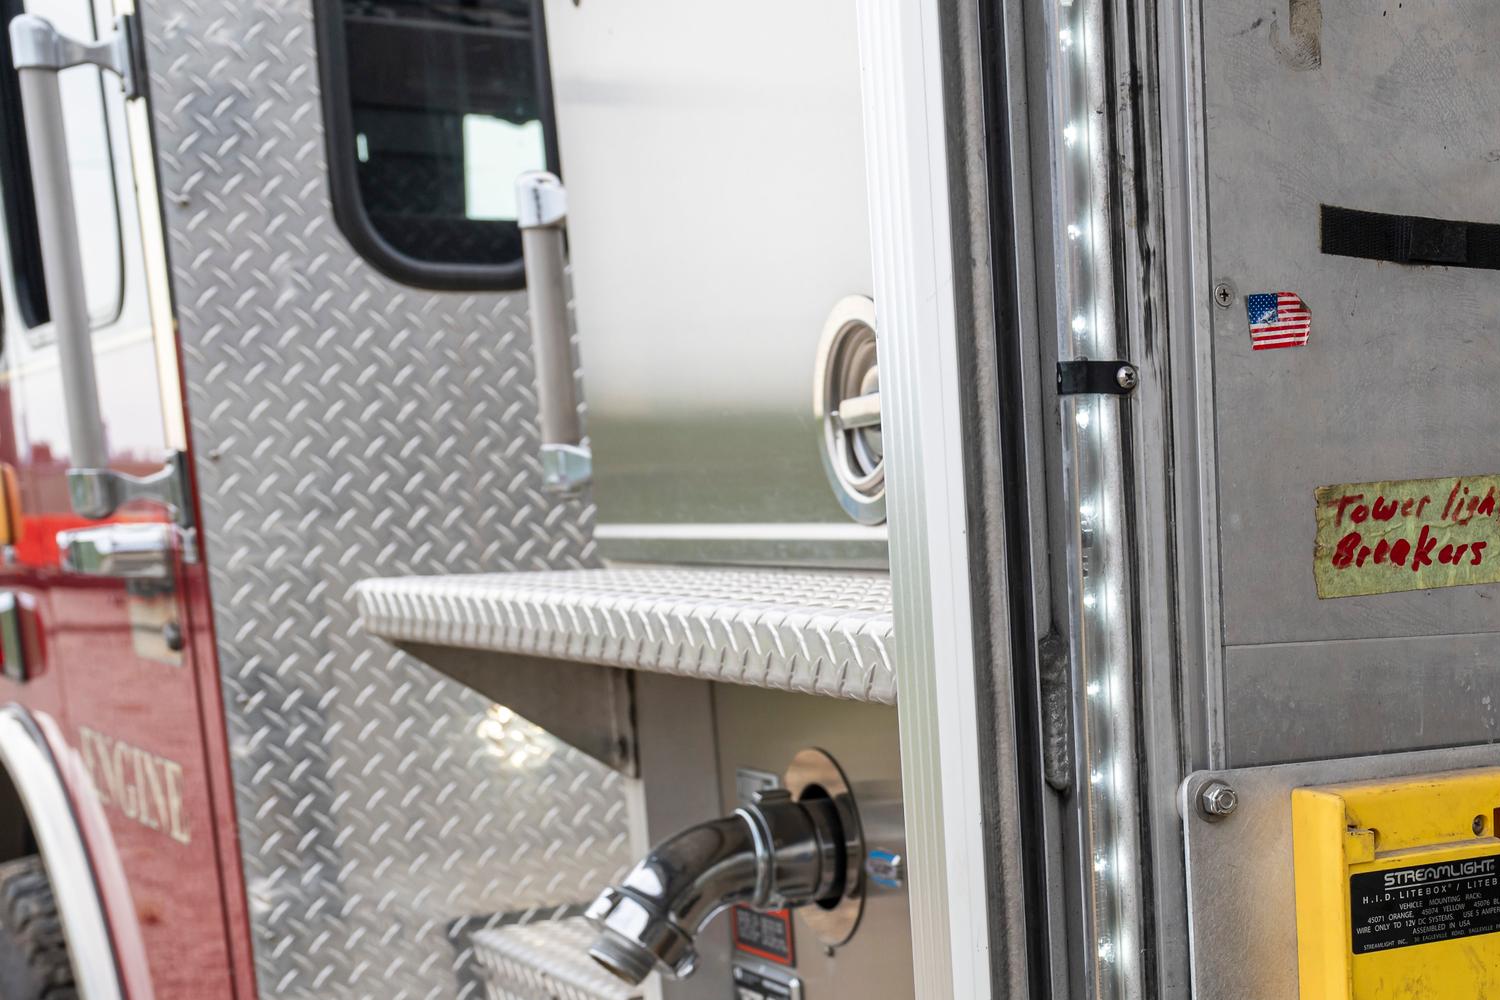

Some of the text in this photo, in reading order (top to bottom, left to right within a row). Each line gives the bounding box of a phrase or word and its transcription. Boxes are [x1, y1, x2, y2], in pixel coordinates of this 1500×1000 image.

[1328, 493, 1431, 528] Tower
[1331, 524, 1487, 572] Breakers
[1384, 859, 1495, 886] STREAMLIGHT
[1362, 893, 1396, 904] H.I.D.
[1399, 901, 1423, 910] VEHICLE
[1429, 896, 1460, 906] MOUNTING
[1367, 915, 1385, 924] 45071
[1421, 907, 1439, 915] 45074
[1442, 903, 1466, 912] YELLOW
[1473, 900, 1490, 908] 45076
[1356, 925, 1371, 934] WIRE
[1374, 923, 1391, 932] ONLY
[1393, 921, 1402, 929] TO
[1405, 919, 1416, 927] 12V
[1418, 917, 1426, 925] DC
[1412, 919, 1471, 934] ASSEMBLED IN USA
[1363, 940, 1395, 950] STREAMLIGHT
